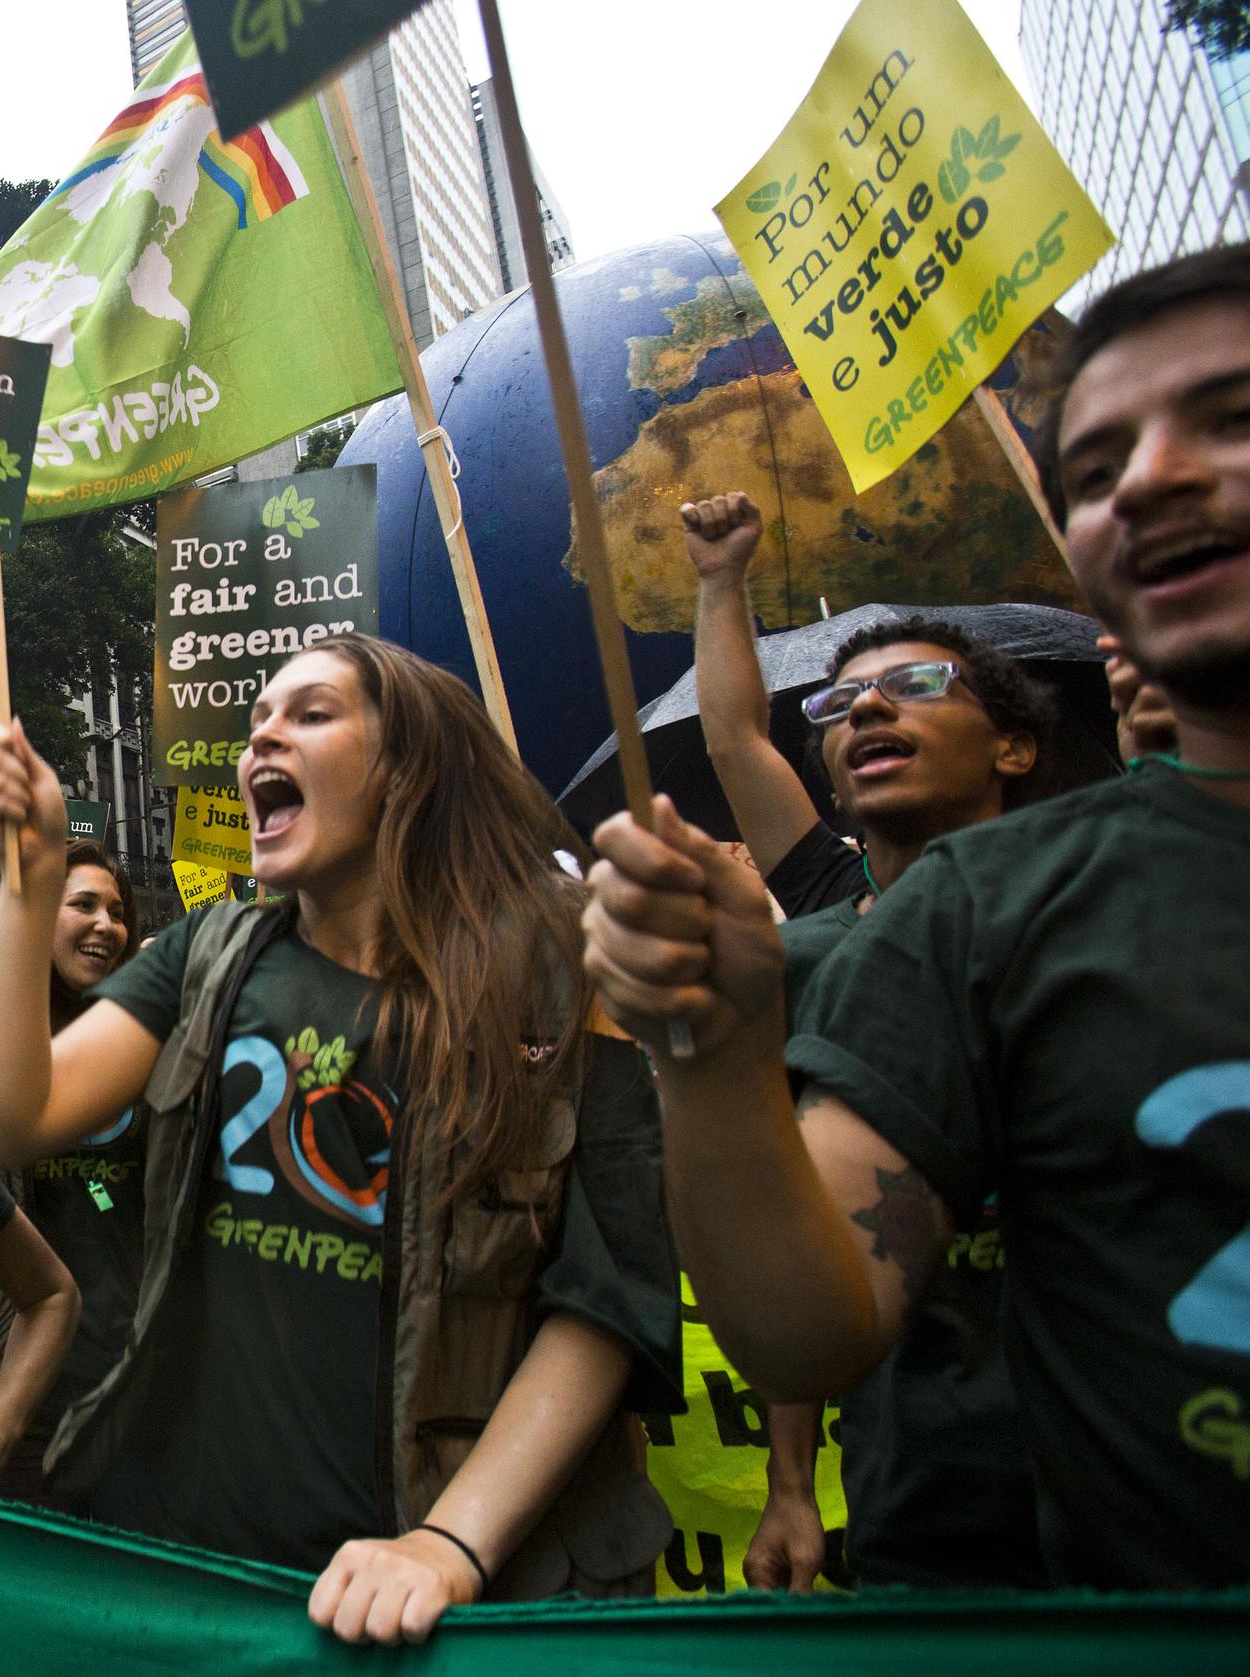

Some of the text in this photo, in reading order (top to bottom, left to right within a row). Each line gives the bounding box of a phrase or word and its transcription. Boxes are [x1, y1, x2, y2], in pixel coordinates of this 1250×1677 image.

[754, 48, 915, 263] Por um
[782, 107, 925, 305] mundo
[803, 182, 933, 342] verde
[832, 196, 989, 391] e justo
[864, 211, 1069, 454] GREENPEACE
[170, 533, 291, 572] For a
[169, 564, 363, 617] fair and
[169, 669, 266, 710] worl
[190, 786, 243, 801] verd
[71, 820, 94, 833] um
[185, 805, 249, 831] e just
[182, 838, 251, 864] GREENPEA
[179, 868, 207, 886] For a
[184, 873, 226, 899] fair and
